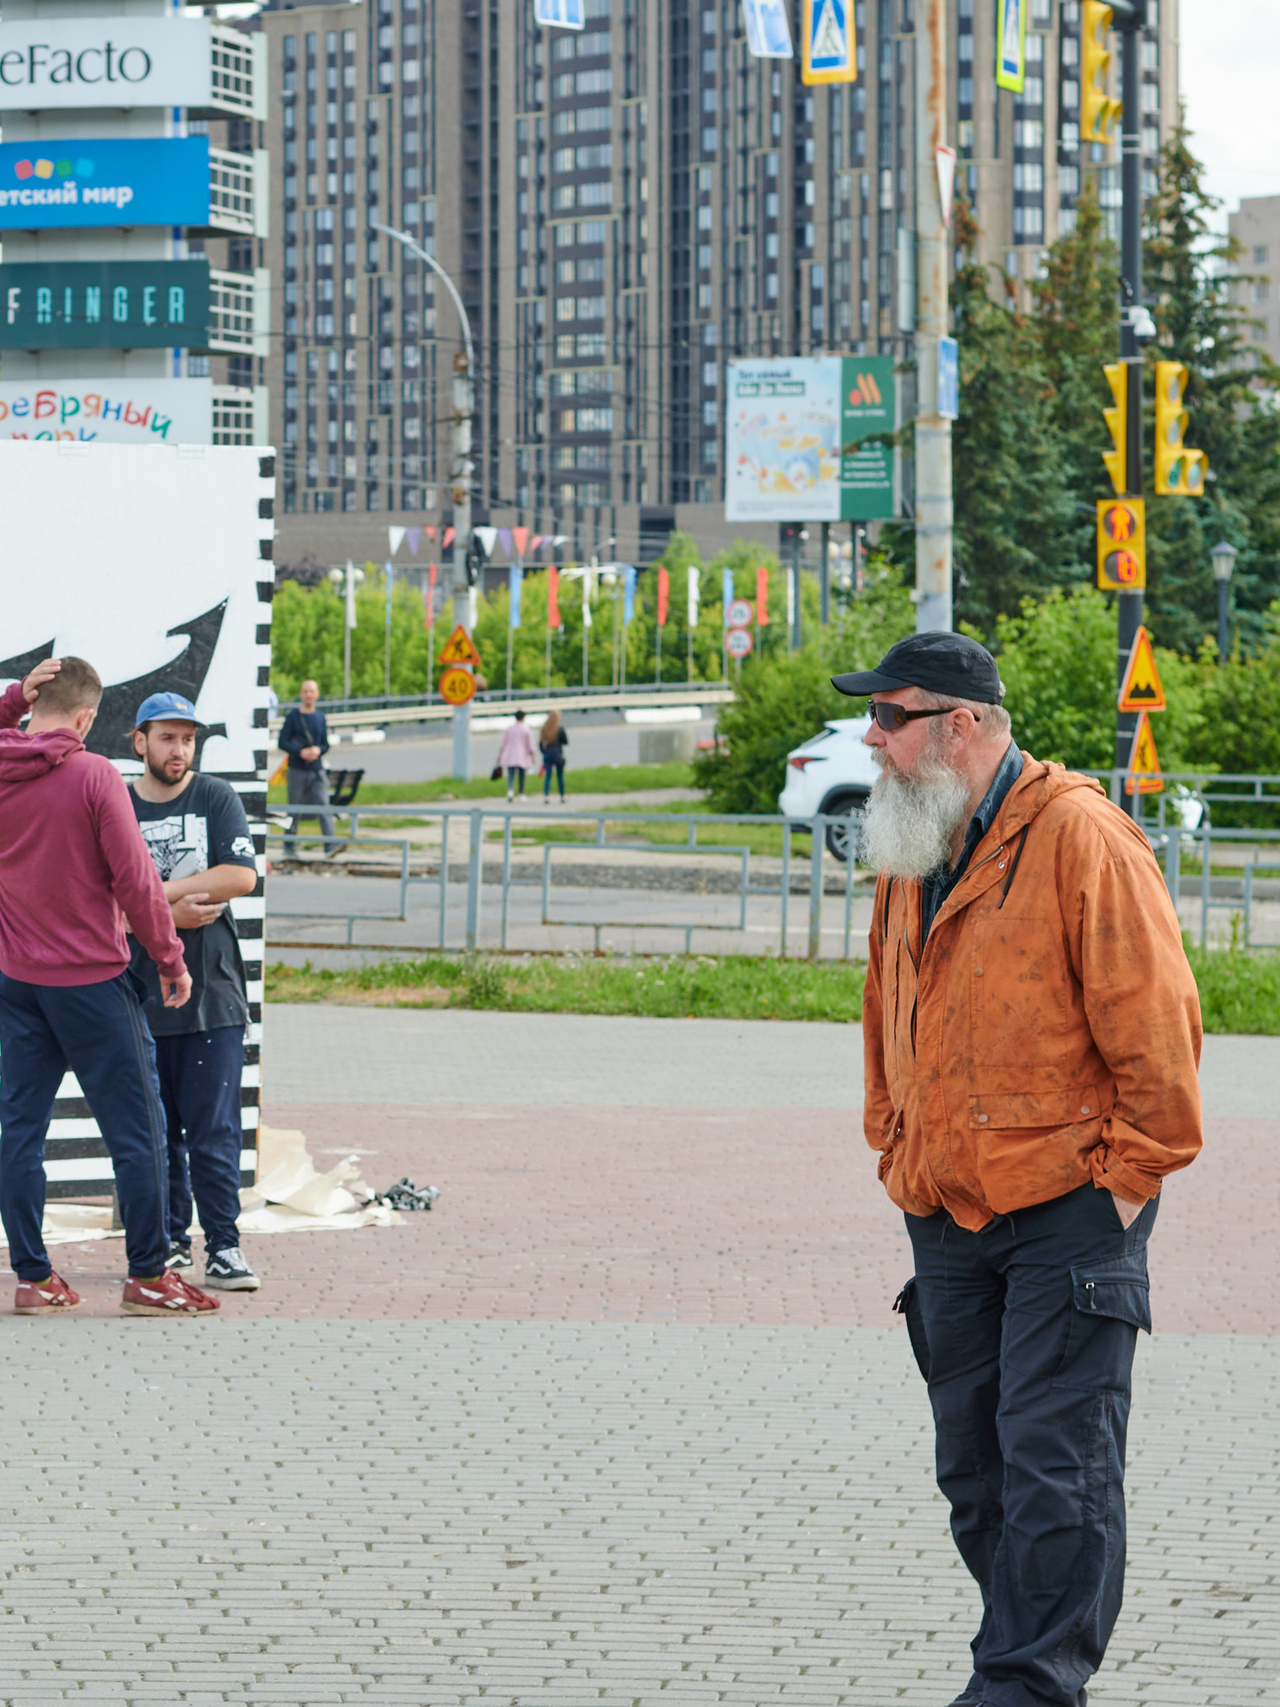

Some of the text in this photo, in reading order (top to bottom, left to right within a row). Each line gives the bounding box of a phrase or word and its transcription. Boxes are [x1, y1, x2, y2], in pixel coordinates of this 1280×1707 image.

[83, 186, 134, 209] мир
[37, 286, 186, 325] RINGER
[448, 678, 468, 696] 40
